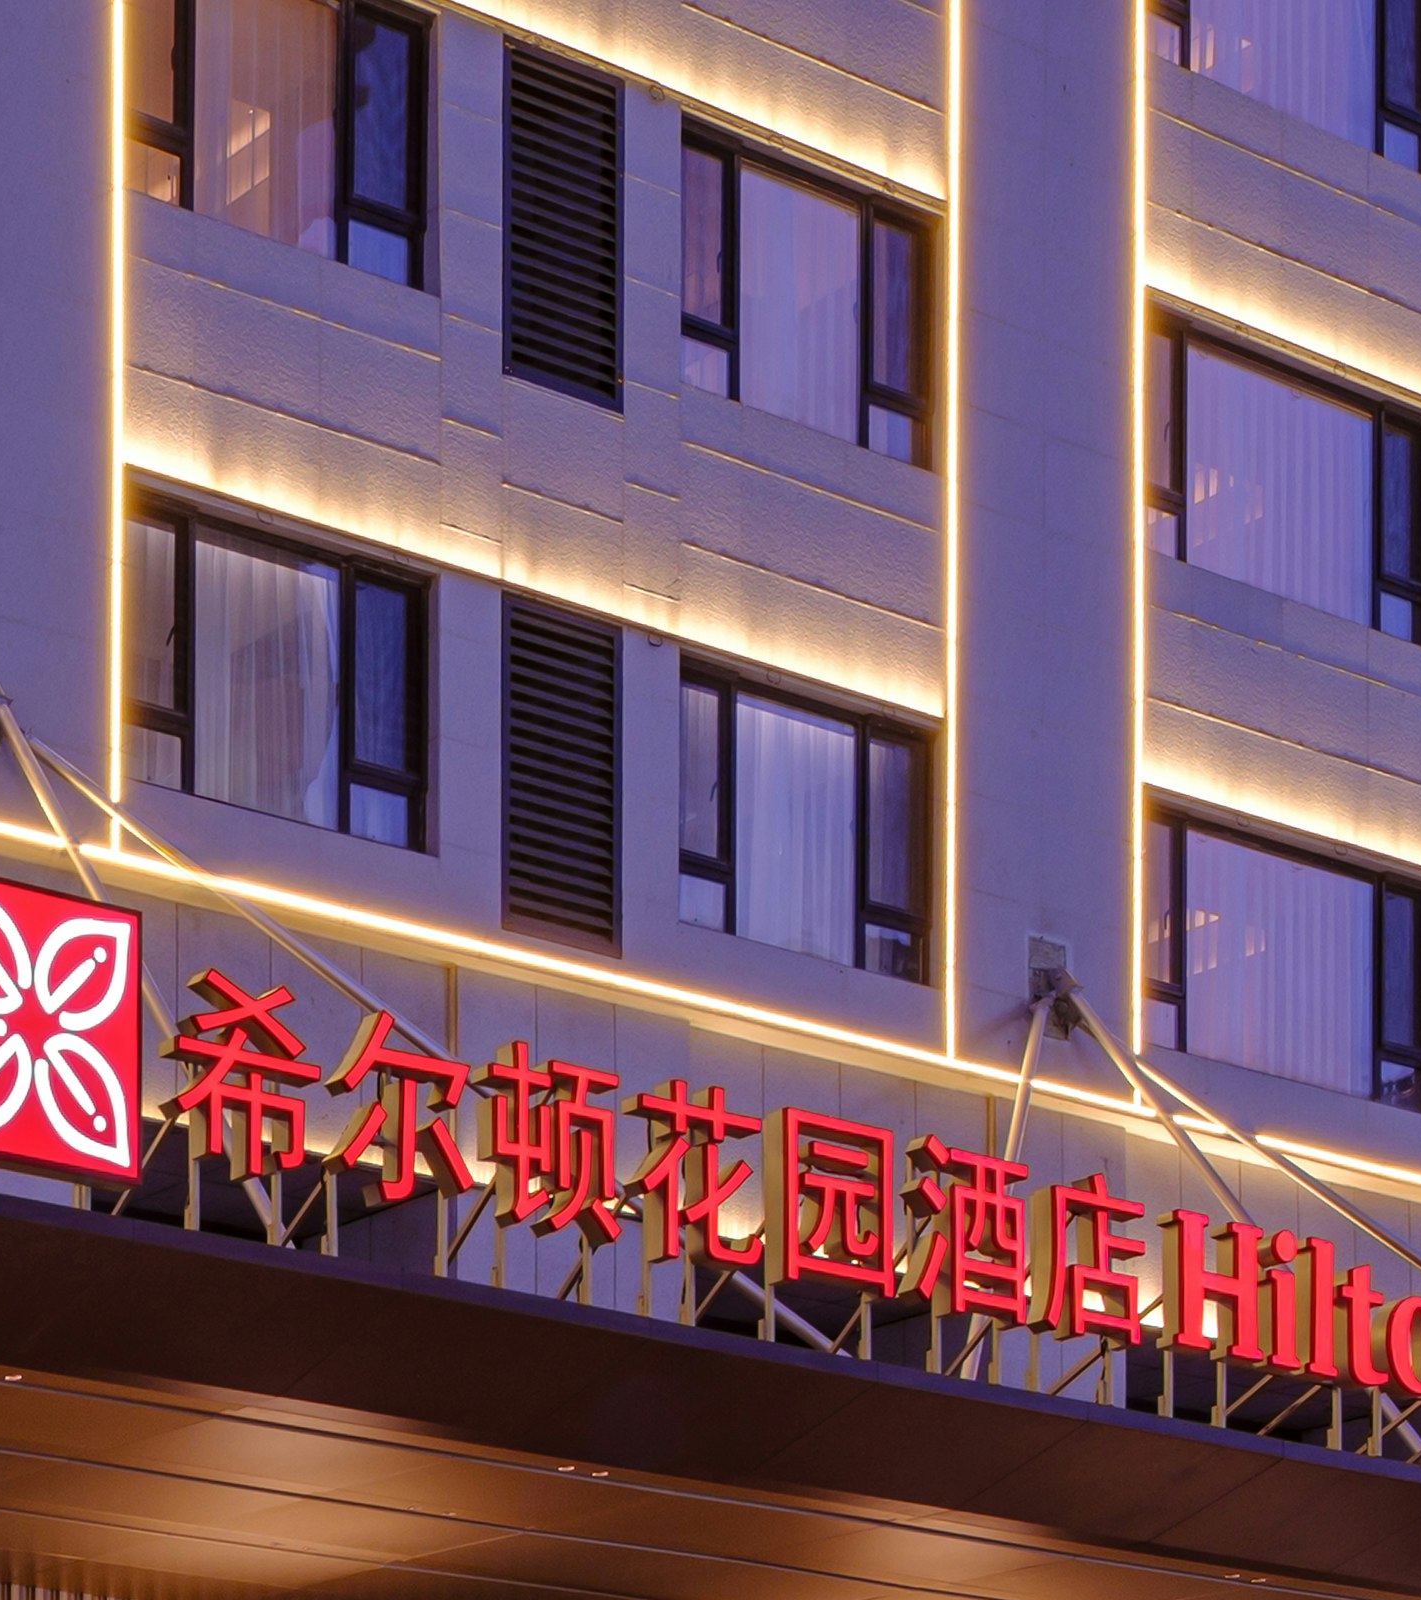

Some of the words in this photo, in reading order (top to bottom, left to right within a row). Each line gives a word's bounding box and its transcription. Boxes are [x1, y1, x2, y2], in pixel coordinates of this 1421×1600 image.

[174, 967, 1146, 1346] 希尔顿花园酒店
